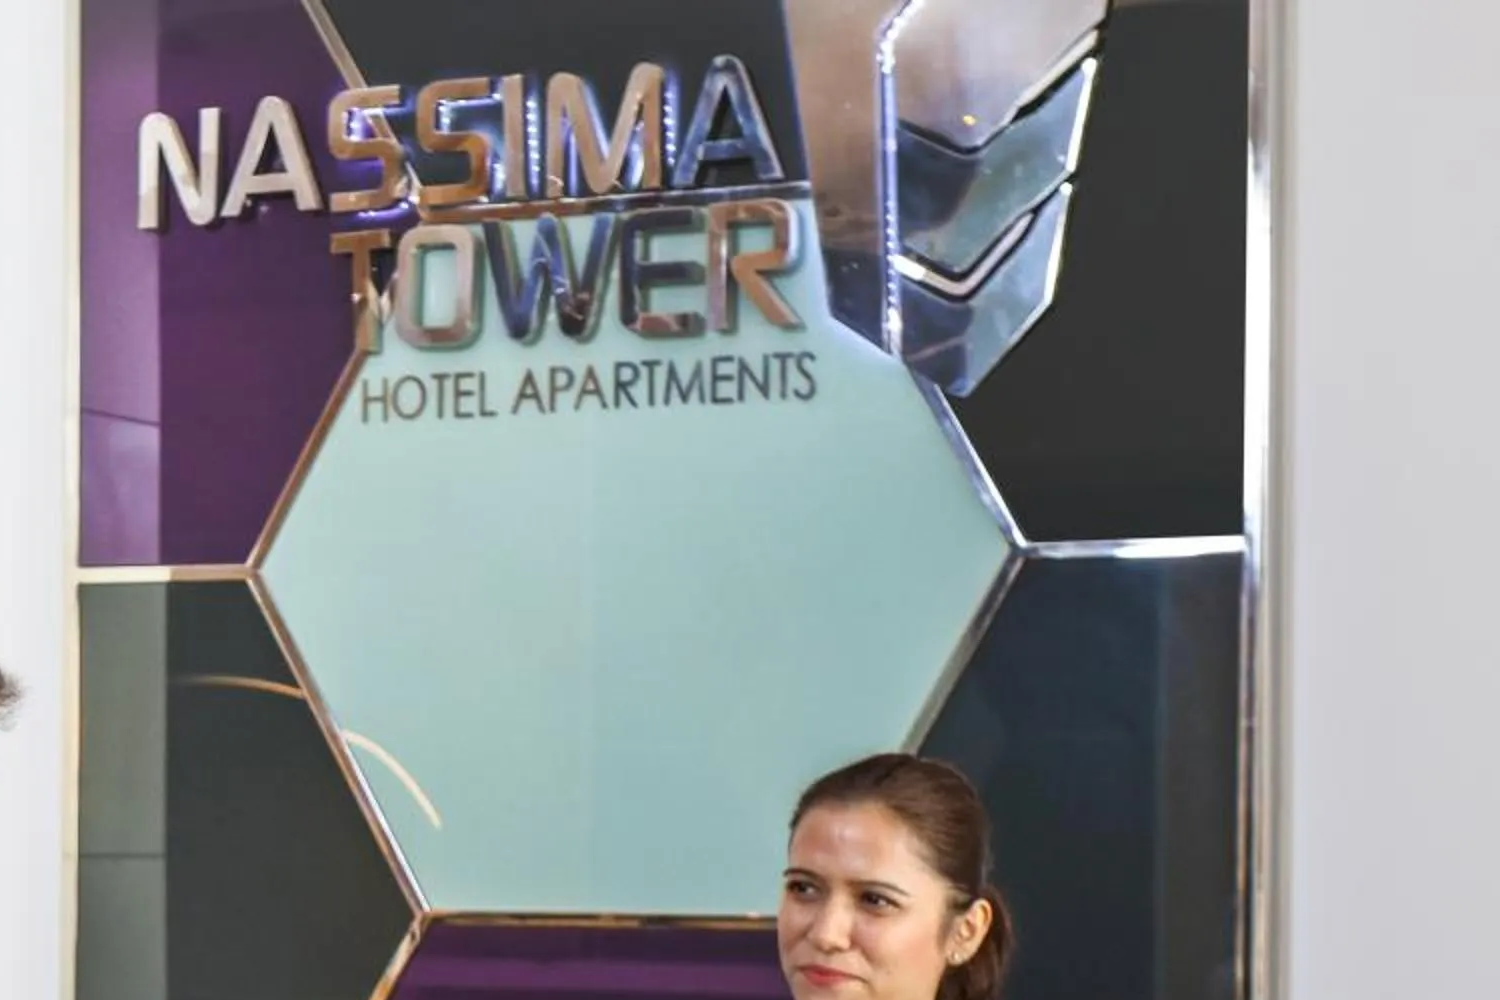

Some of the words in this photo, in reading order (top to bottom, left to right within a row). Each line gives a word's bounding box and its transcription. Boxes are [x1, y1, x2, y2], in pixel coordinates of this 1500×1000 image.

[137, 54, 785, 229] NASSIMA
[330, 199, 806, 352] TOWER
[361, 372, 497, 422] HOTEL
[512, 351, 817, 414] APARTMENTS
